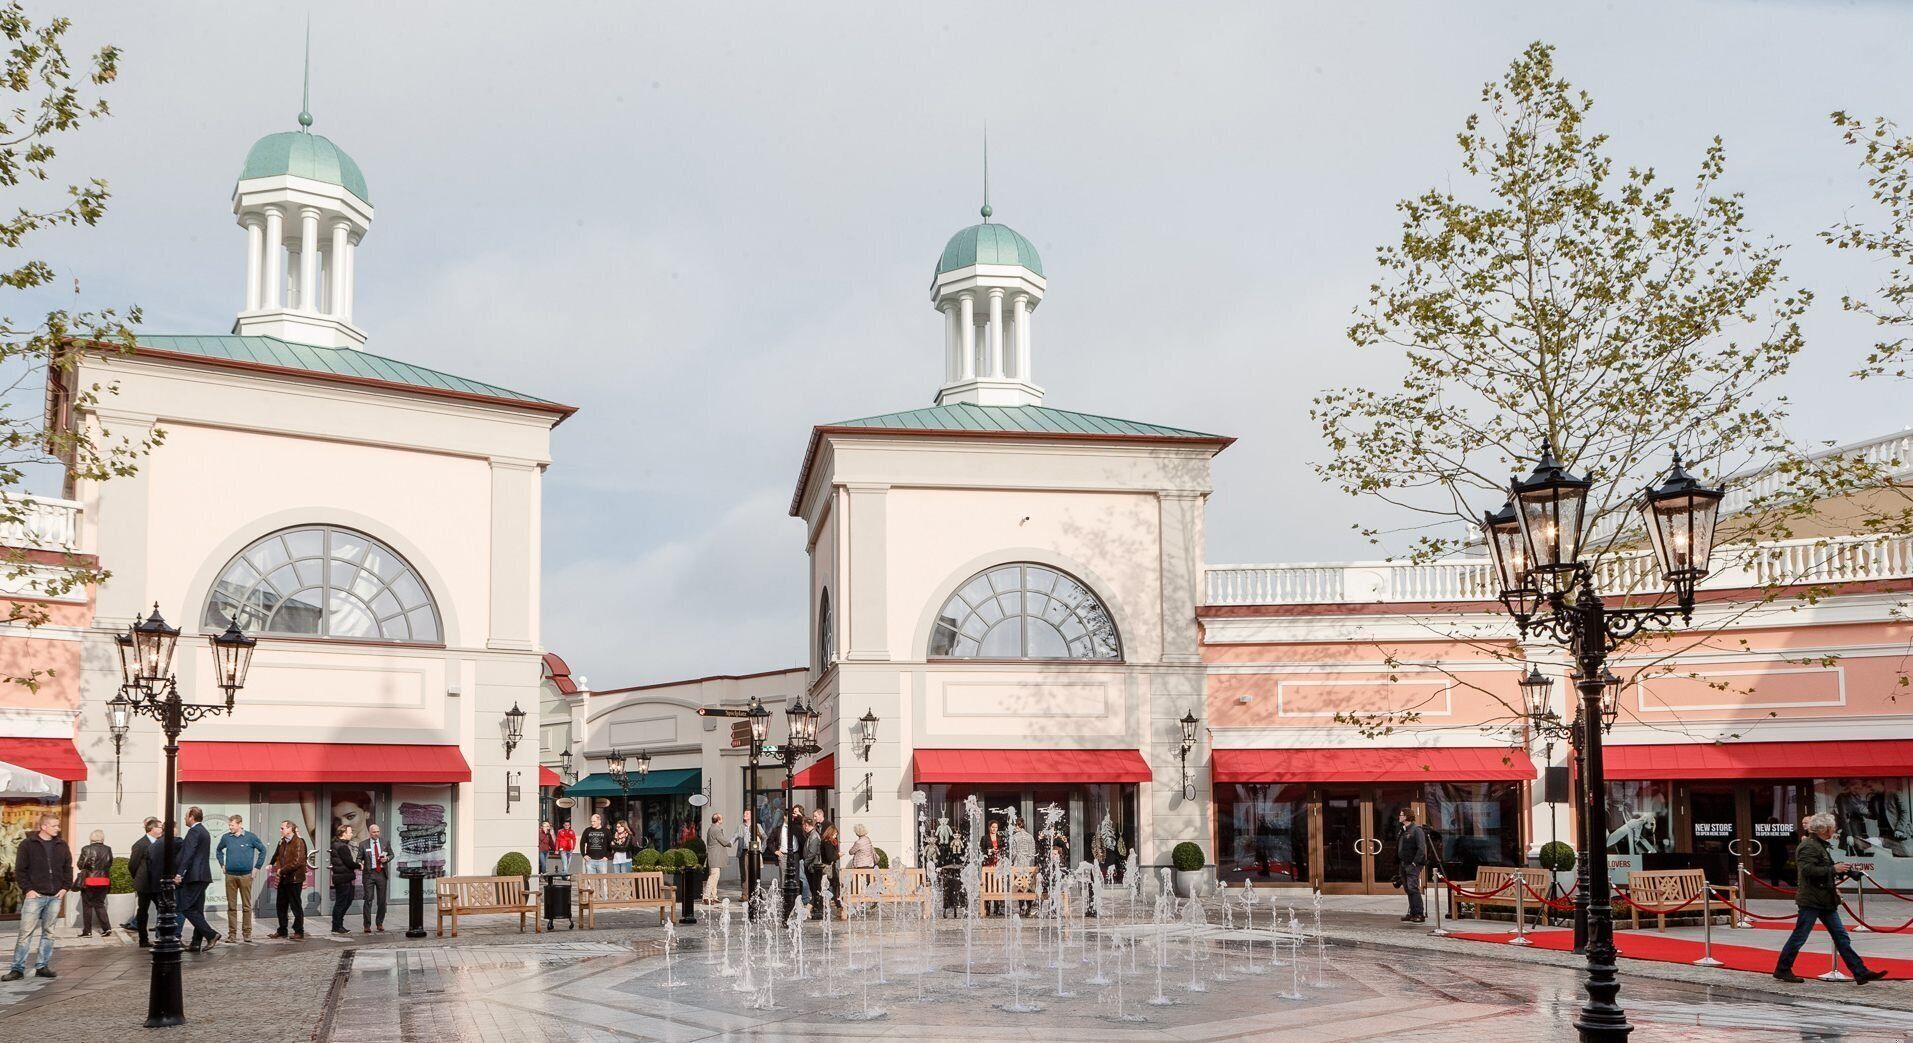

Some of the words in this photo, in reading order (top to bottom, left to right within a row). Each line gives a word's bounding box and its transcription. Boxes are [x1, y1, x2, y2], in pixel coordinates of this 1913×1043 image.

[1695, 823, 1710, 831] NEW
[1711, 823, 1733, 831] STORE
[1755, 823, 1771, 831] NEW
[1771, 823, 1794, 831] STORE
